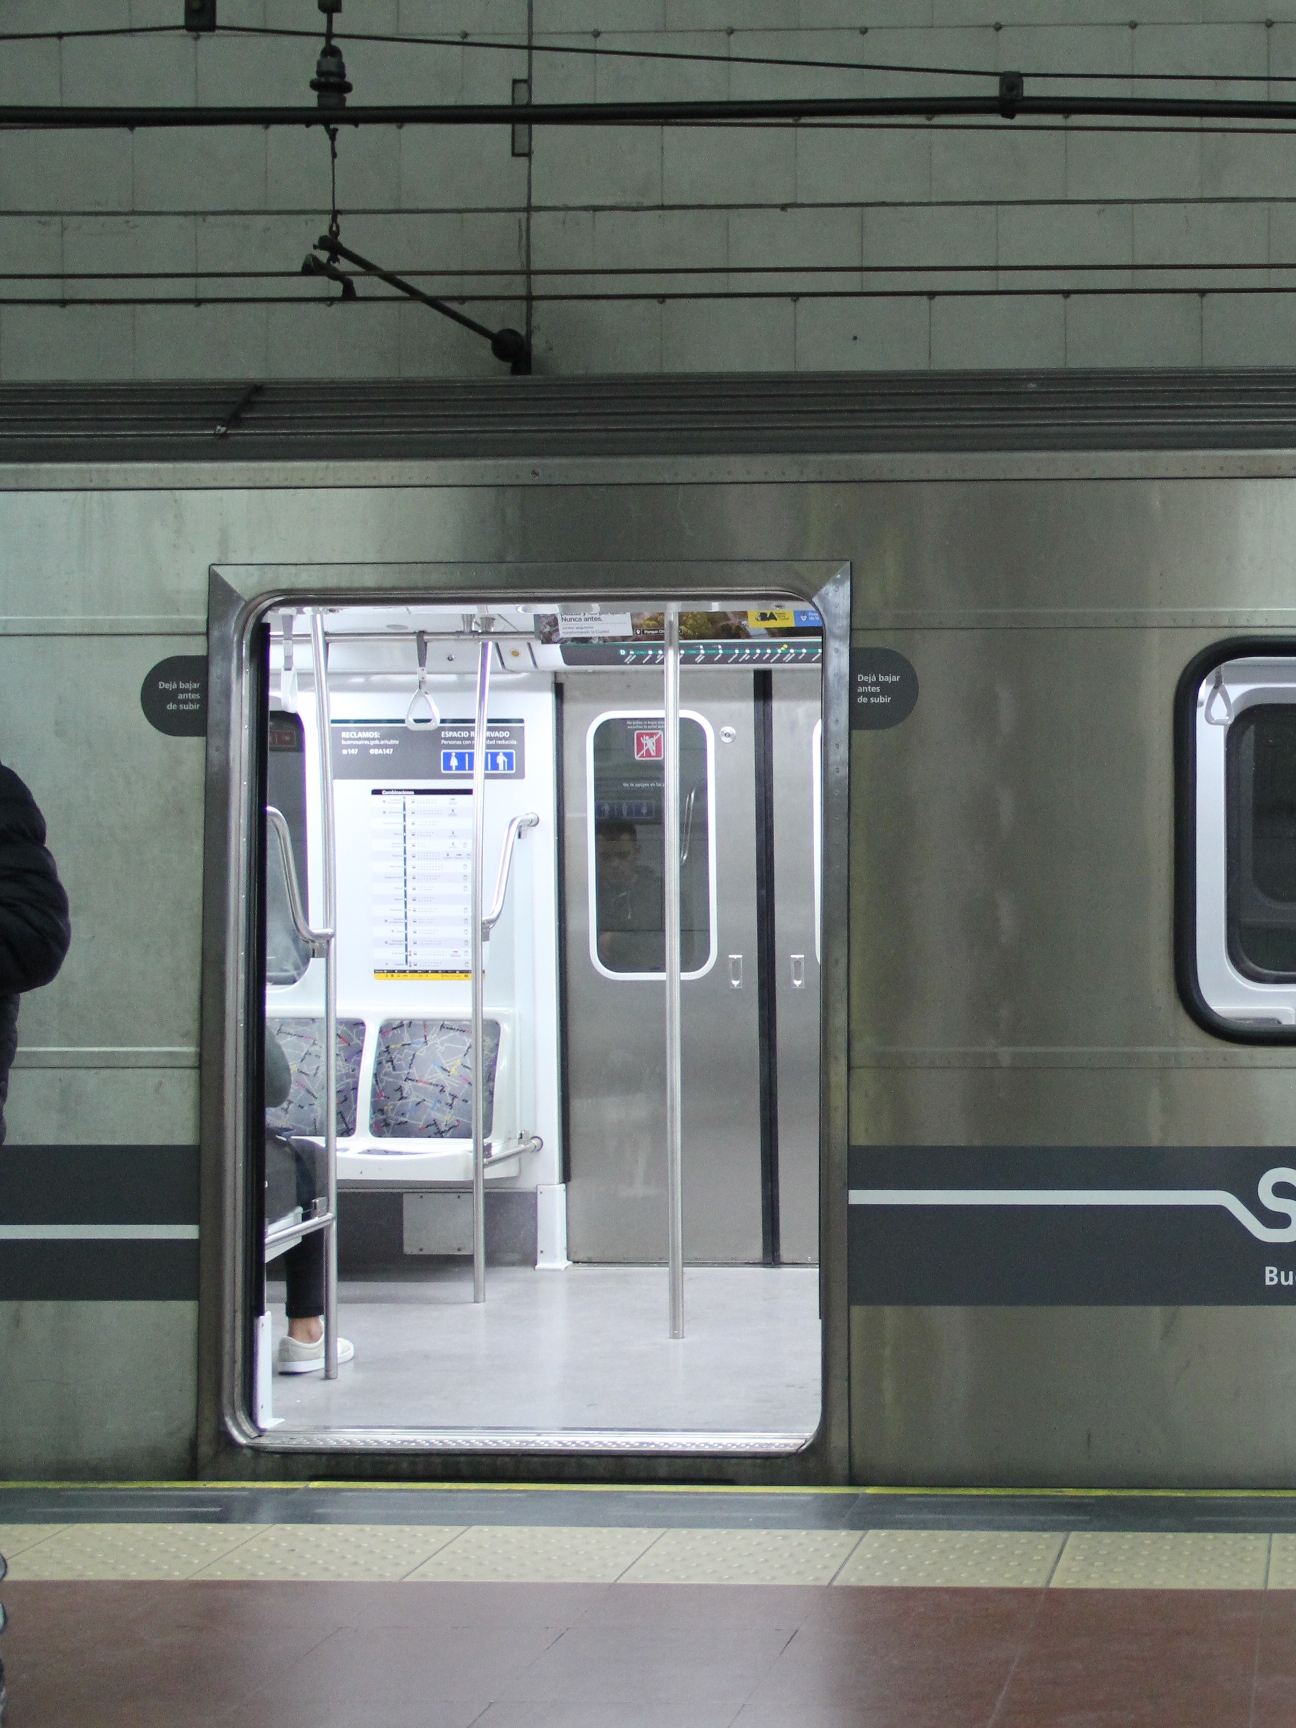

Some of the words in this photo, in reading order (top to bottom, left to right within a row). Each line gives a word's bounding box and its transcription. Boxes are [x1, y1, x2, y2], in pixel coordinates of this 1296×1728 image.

[857, 673, 877, 683] Dejá
[878, 673, 901, 683] bajar
[158, 681, 177, 690] Dejá
[179, 681, 200, 690] bajar
[857, 685, 881, 693] antes
[857, 695, 868, 703] de
[870, 695, 892, 703] subir
[167, 702, 177, 710] de
[179, 702, 200, 710] subir
[470, 730, 510, 738] RRVADO
